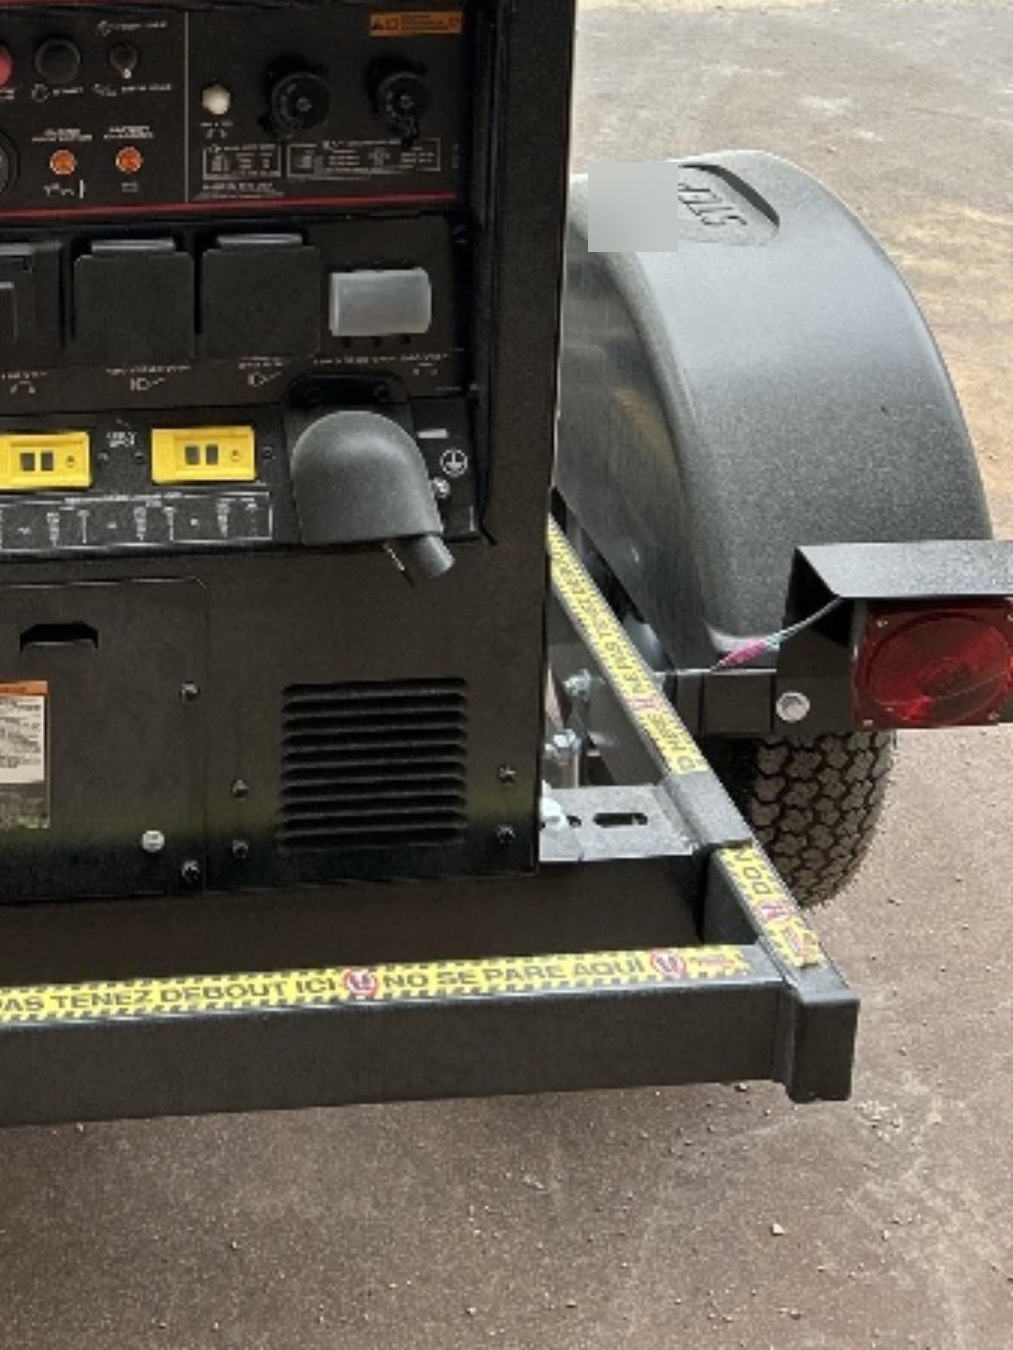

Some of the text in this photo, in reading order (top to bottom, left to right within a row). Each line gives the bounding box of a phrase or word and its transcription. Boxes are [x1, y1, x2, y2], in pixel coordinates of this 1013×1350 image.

[49, 989, 154, 1011] TENEZ
[295, 976, 337, 994] ICI
[383, 973, 430, 988] NO
[436, 971, 478, 987] SE
[483, 964, 558, 984] PARE
